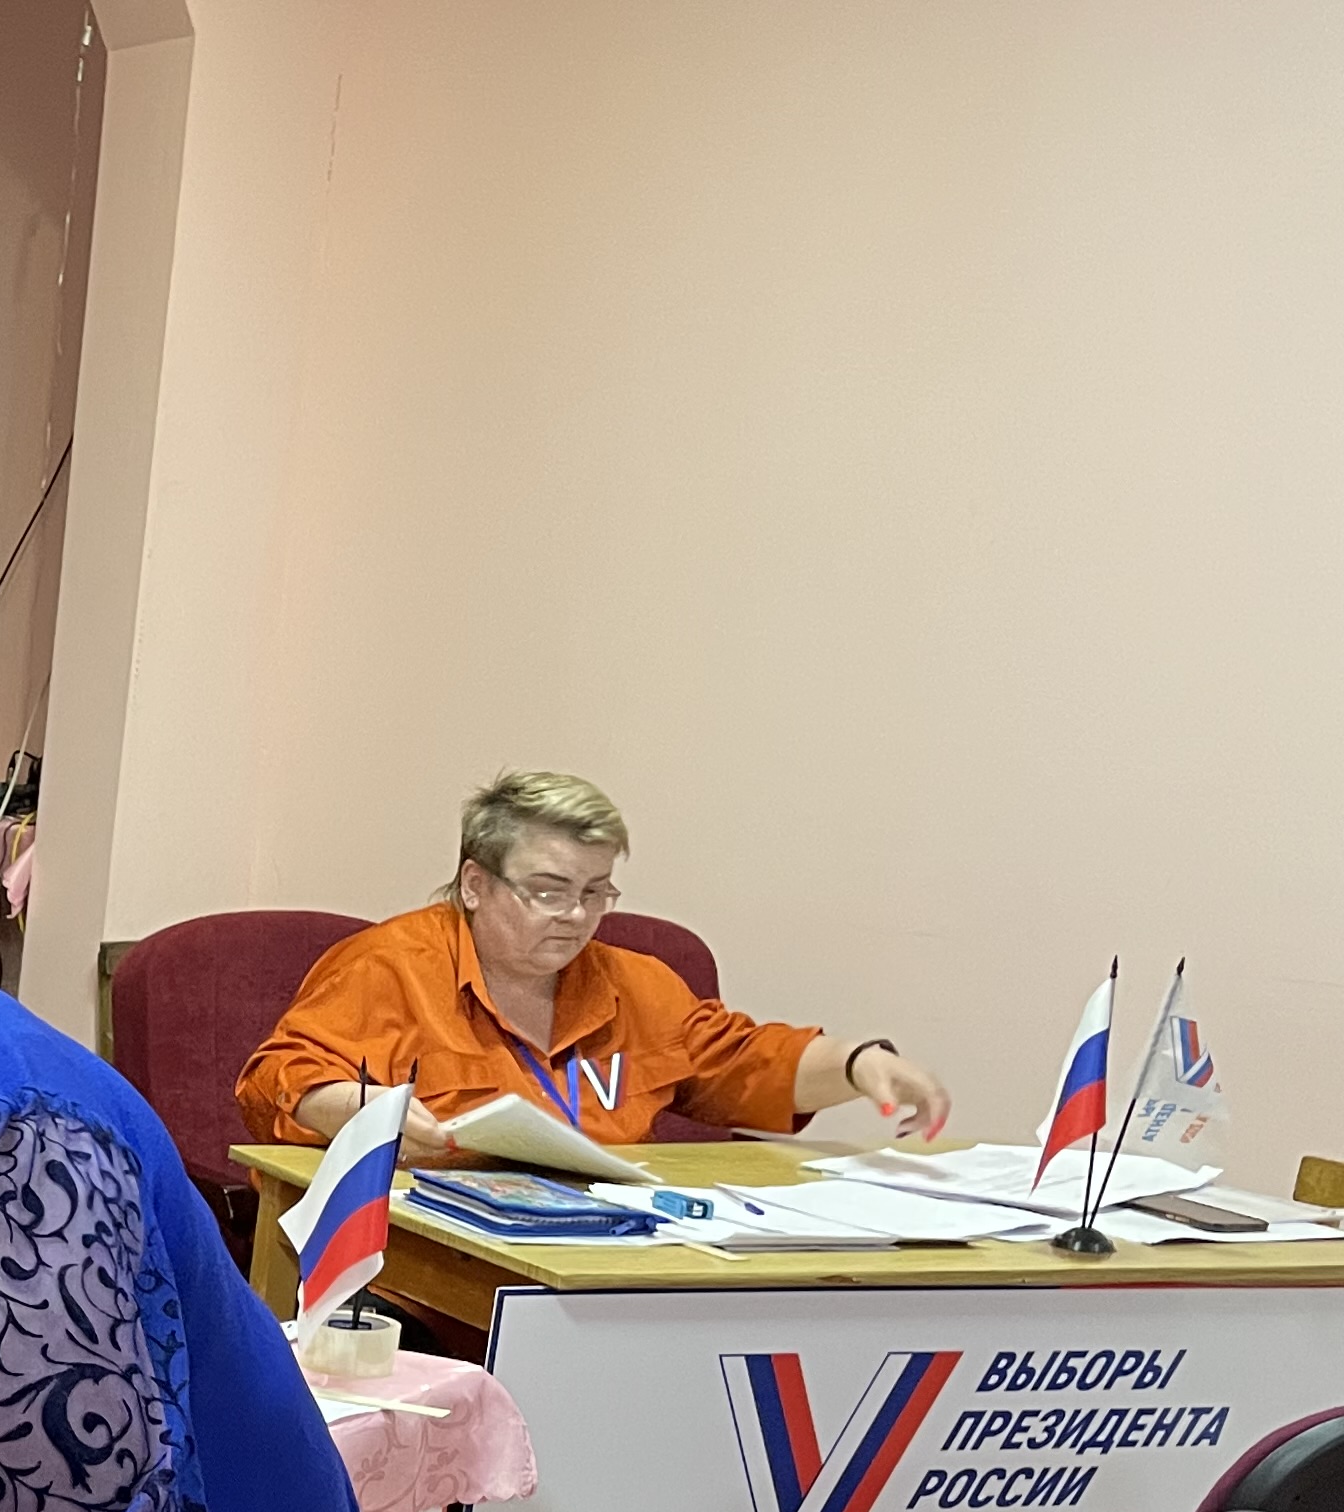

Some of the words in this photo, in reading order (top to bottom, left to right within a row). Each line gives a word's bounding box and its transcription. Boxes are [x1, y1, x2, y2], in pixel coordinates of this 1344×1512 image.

[976, 1349, 1188, 1393] ВЫБОРЫ
[941, 1406, 1230, 1455] ПРЕЗИДЕНТА
[906, 1466, 1099, 1510] РОССИИ
